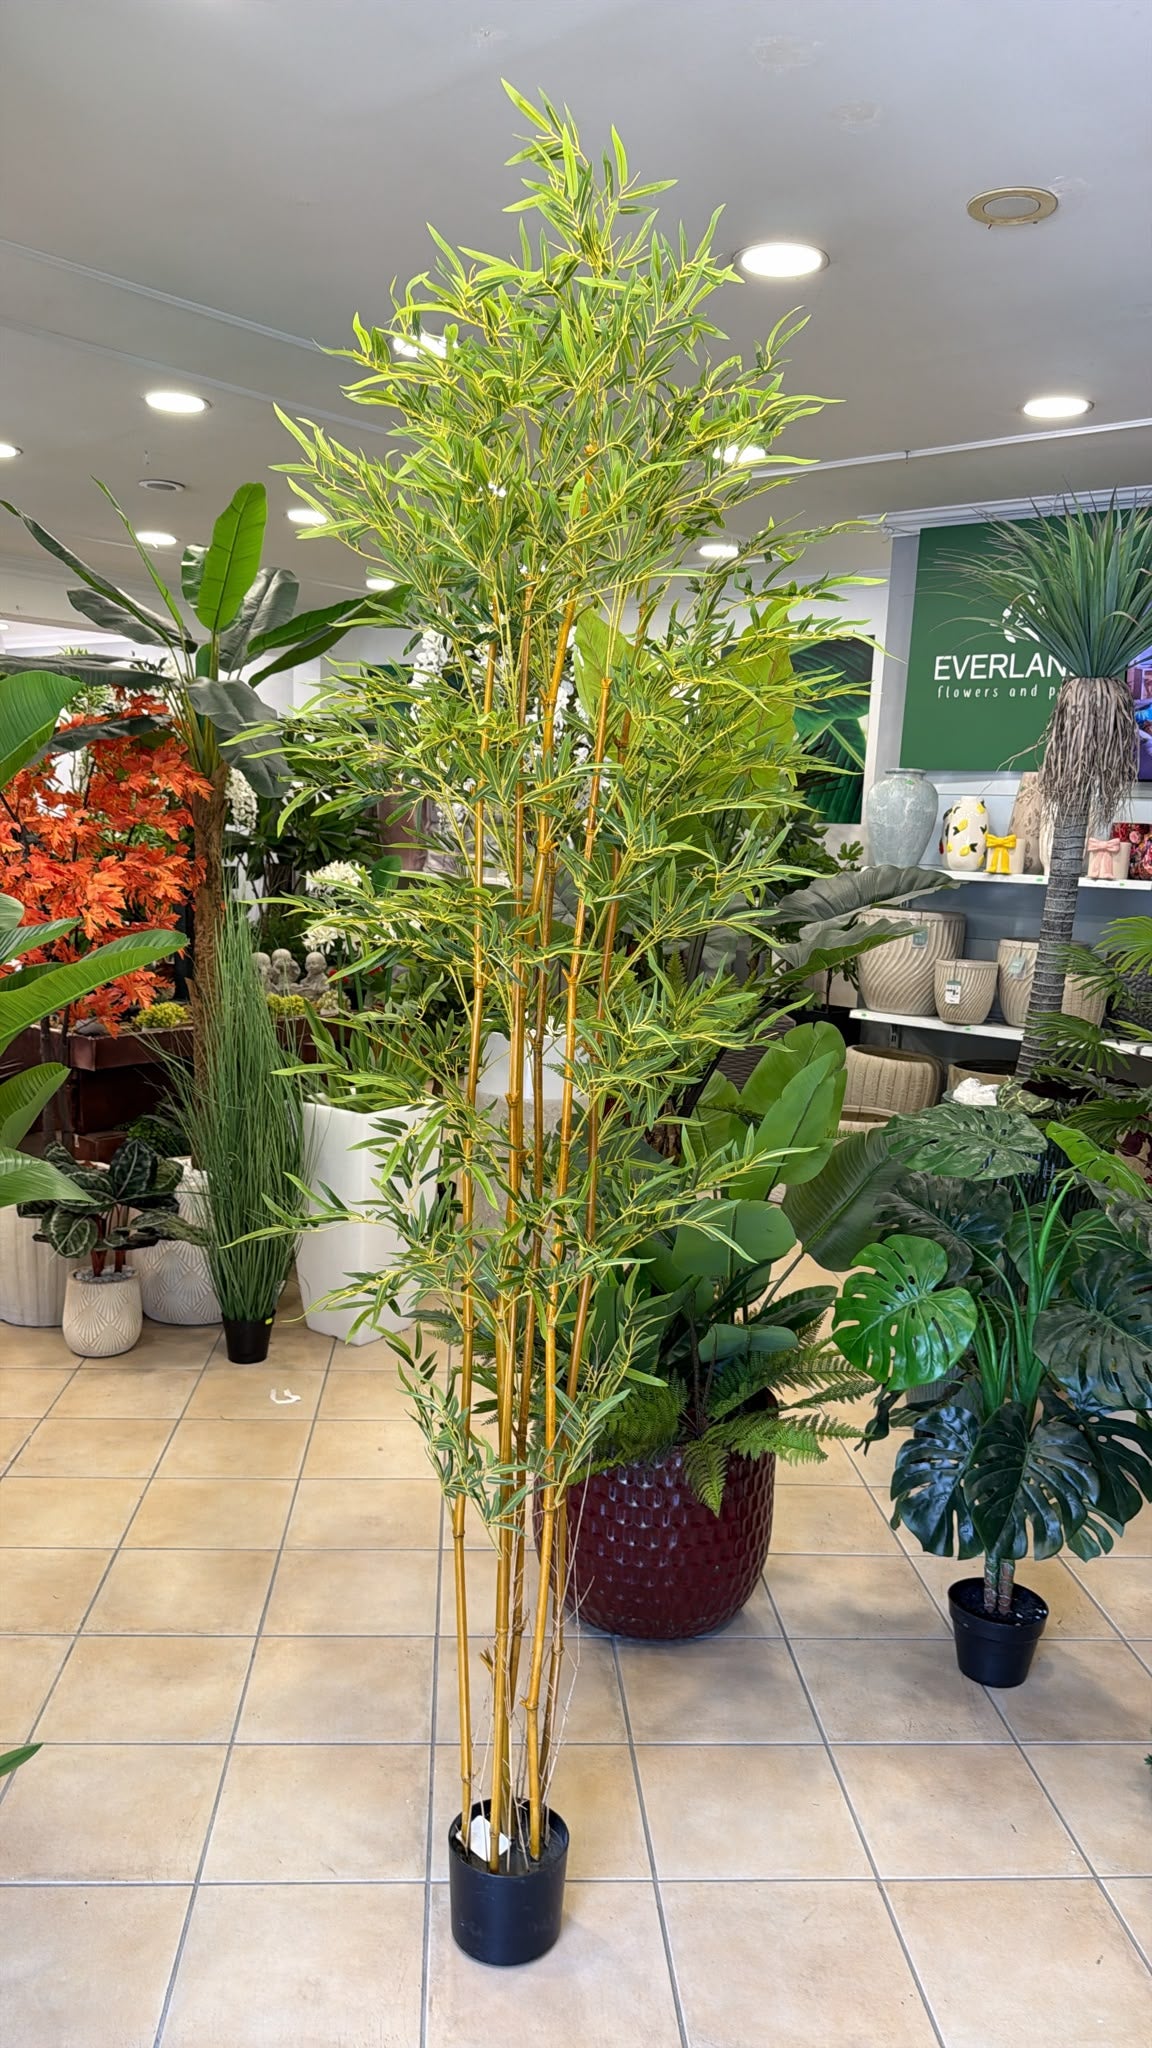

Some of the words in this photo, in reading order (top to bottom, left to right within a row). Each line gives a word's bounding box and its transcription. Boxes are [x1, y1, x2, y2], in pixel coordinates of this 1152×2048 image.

[934, 652, 1076, 680] EVERLAN
[937, 685, 999, 699] flowers
[1009, 684, 1038, 698] and
